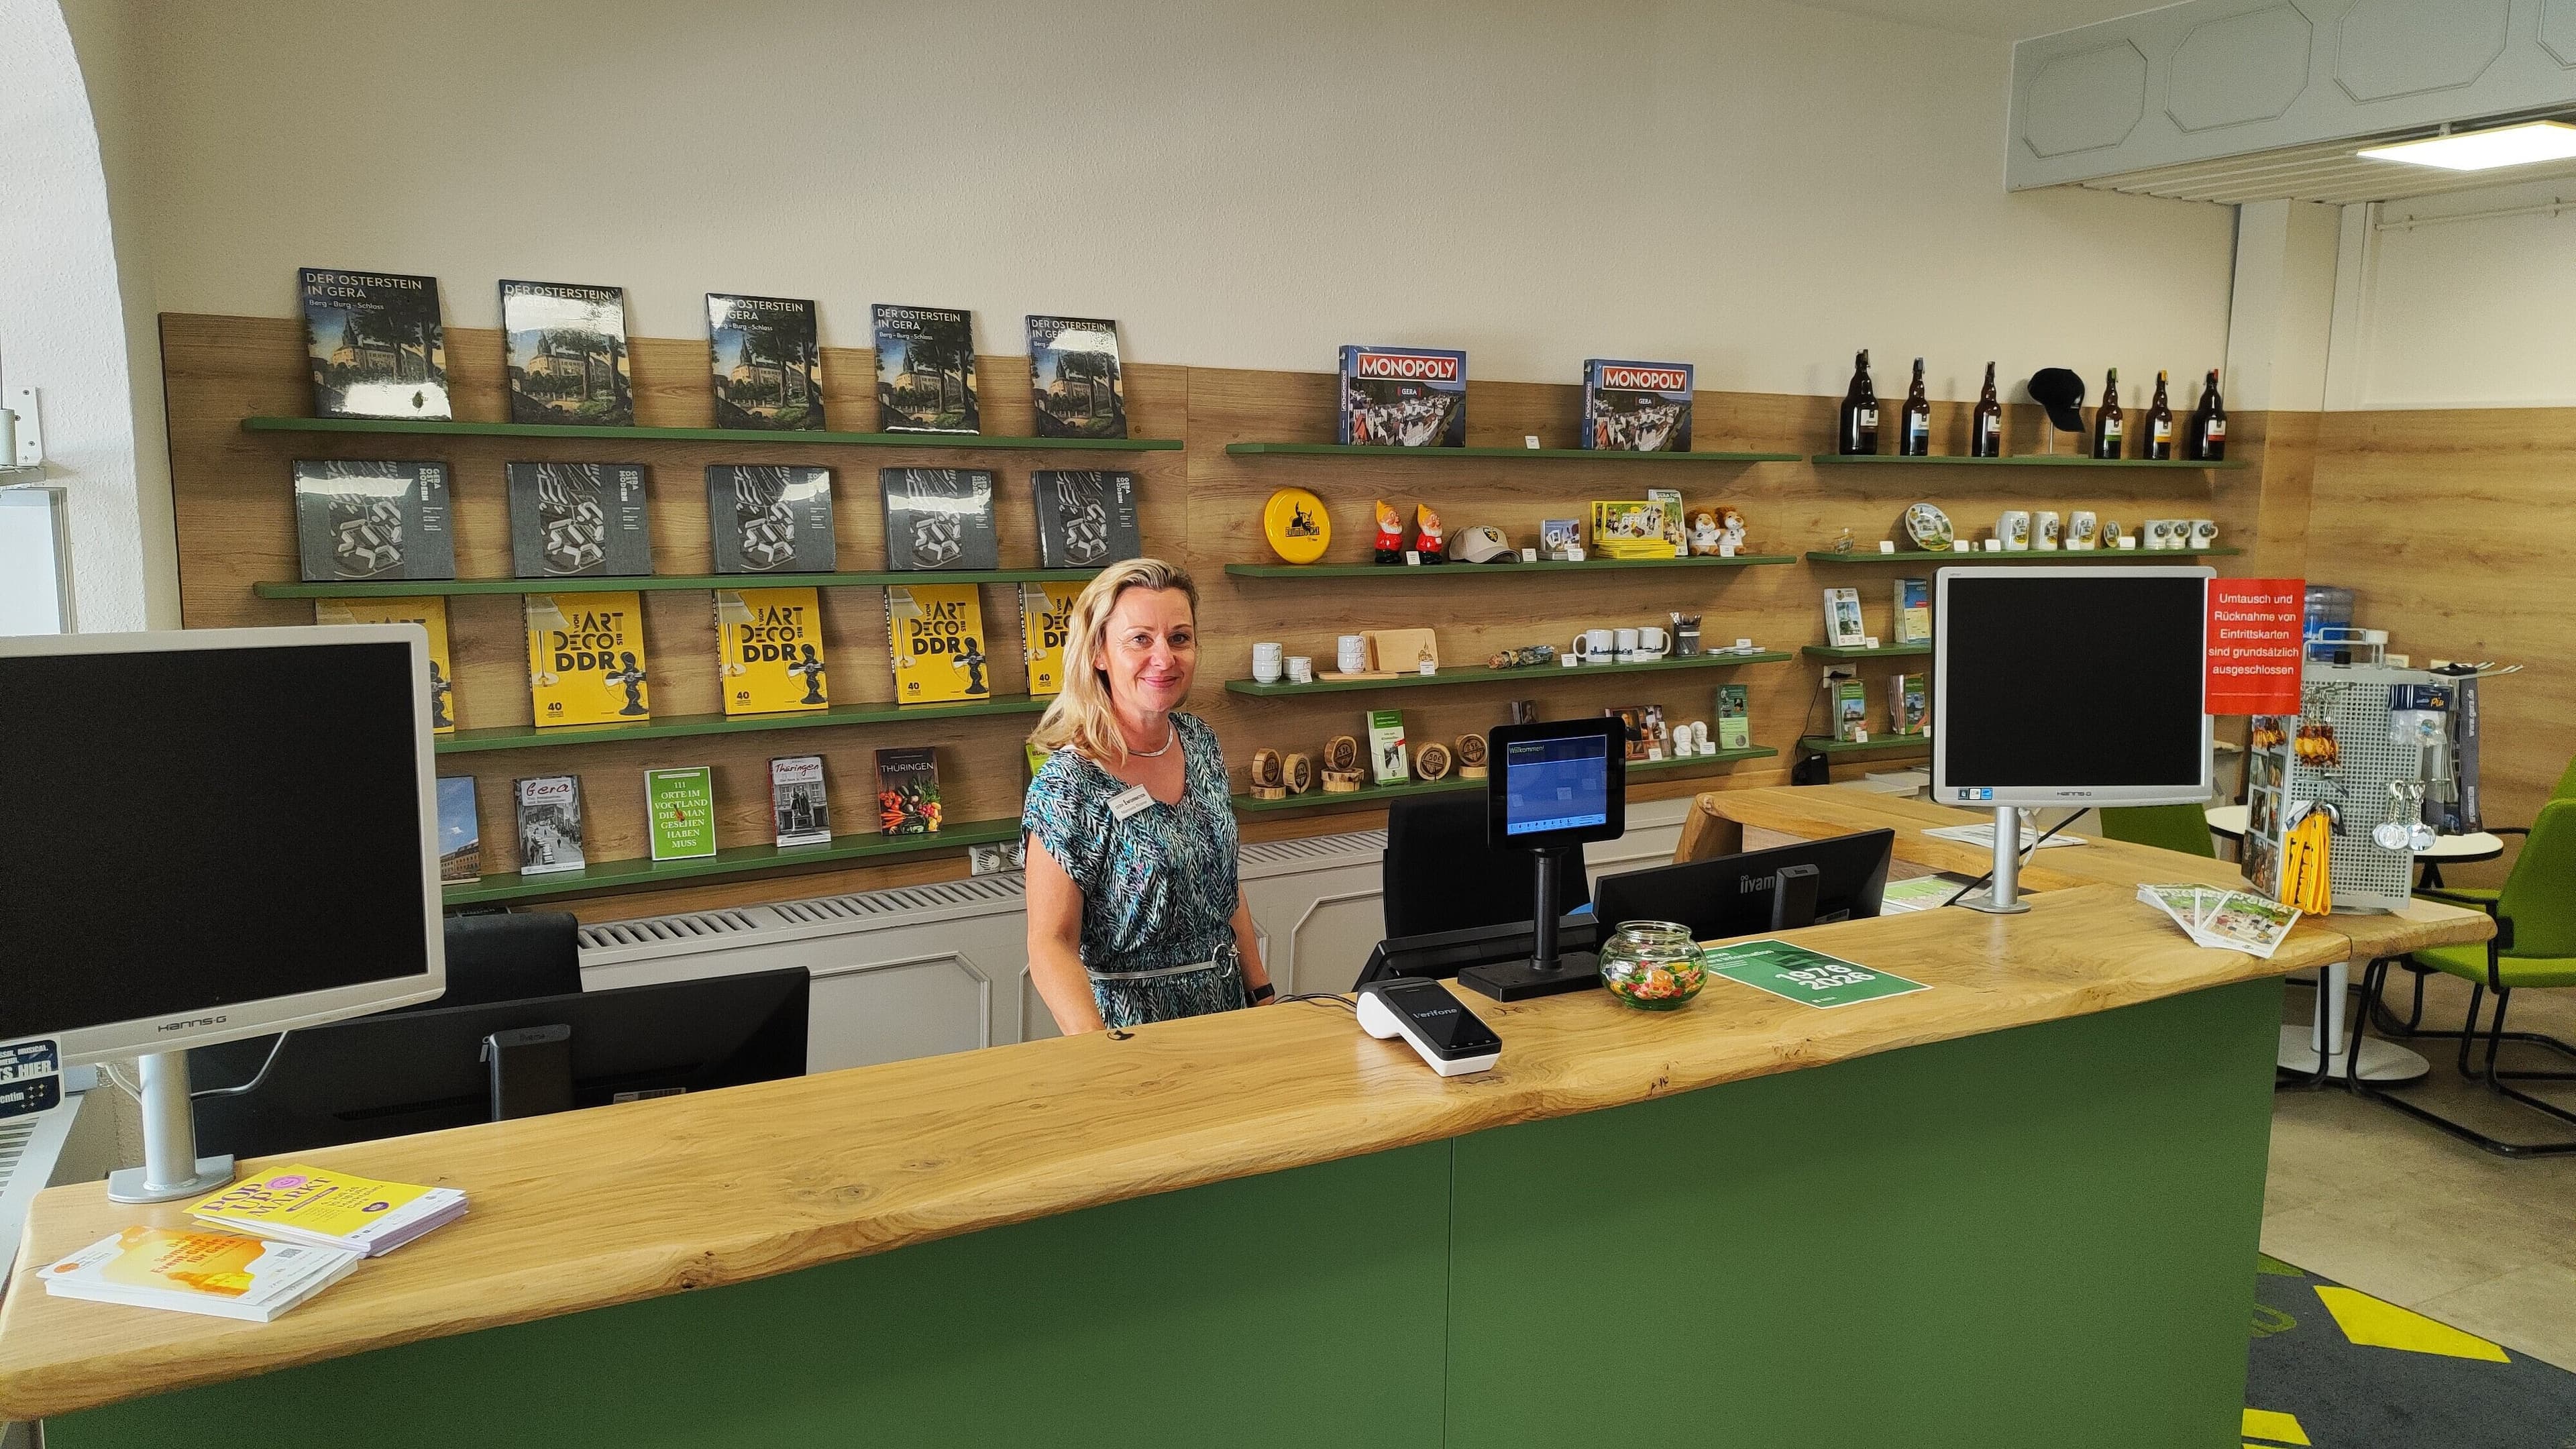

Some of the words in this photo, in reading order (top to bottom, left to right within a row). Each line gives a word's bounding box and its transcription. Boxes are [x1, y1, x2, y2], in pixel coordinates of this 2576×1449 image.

[306, 272, 334, 284] DER
[339, 275, 422, 290] OSTERSTEIN
[307, 285, 323, 295] IN
[327, 287, 366, 298] GERA
[505, 284, 530, 295] DER
[534, 286, 610, 300] OSTERSTEIN
[309, 299, 327, 307] Berg
[333, 301, 352, 309] Burg
[358, 302, 384, 310] Schloss
[738, 300, 804, 312] OSTERSTEIN
[727, 310, 759, 321] GERA
[877, 309, 898, 318] DER
[900, 310, 961, 322] OSTERSTEIN
[733, 323, 747, 331] Burg
[878, 319, 890, 328] IN
[892, 320, 920, 330] GERA
[1031, 319, 1050, 328] DER
[1052, 321, 1106, 331] OSTERSTEIN
[1032, 329, 1043, 337] IN
[1361, 357, 1455, 378] MONOPOLY
[1605, 370, 1684, 389] MONOPOLY
[419, 468, 429, 501] MODERN
[433, 468, 441, 490] GERA
[631, 470, 639, 490] GERA
[619, 470, 629, 502] MODERN
[2219, 593, 2271, 604] Umtausch
[2273, 594, 2293, 604] und
[766, 604, 804, 626] ART
[932, 600, 966, 621] ART
[2214, 610, 2275, 622] Rücknahme
[2278, 612, 2296, 622] von
[582, 610, 623, 633] ART
[2220, 629, 2290, 639] Eintrittskarten
[912, 637, 962, 655] DDR
[2208, 646, 2230, 657] sind
[2233, 647, 2299, 659] grundsätzlich
[743, 643, 798, 663] DDR
[555, 651, 616, 672] DDR
[2212, 664, 2294, 676] ausgeschlossen
[1039, 674, 1051, 682] 40
[737, 691, 750, 700] 40
[547, 702, 562, 710] 40
[1509, 745, 1544, 754] Willkommen!
[775, 763, 819, 777] Thüringen
[881, 761, 934, 773] THÜRINGEN
[527, 782, 570, 797] Gera
[661, 790, 687, 799] ORTE
[655, 799, 708, 810] VOGTLAND
[659, 811, 676, 819] DIE
[684, 809, 705, 817] MAN
[661, 819, 704, 828] GESEHEN
[667, 829, 700, 839] HABEN
[672, 839, 697, 848] MUSS
[1740, 875, 1776, 894] iiyam
[1775, 965, 1852, 981] 1976
[1798, 972, 1876, 990] 2026
[1412, 1007, 1458, 1020] Verifone
[18, 1060, 52, 1077] HIER
[201, 1183, 262, 1212] POP
[231, 1191, 273, 1210] UP
[248, 1177, 333, 1217] MARKT
